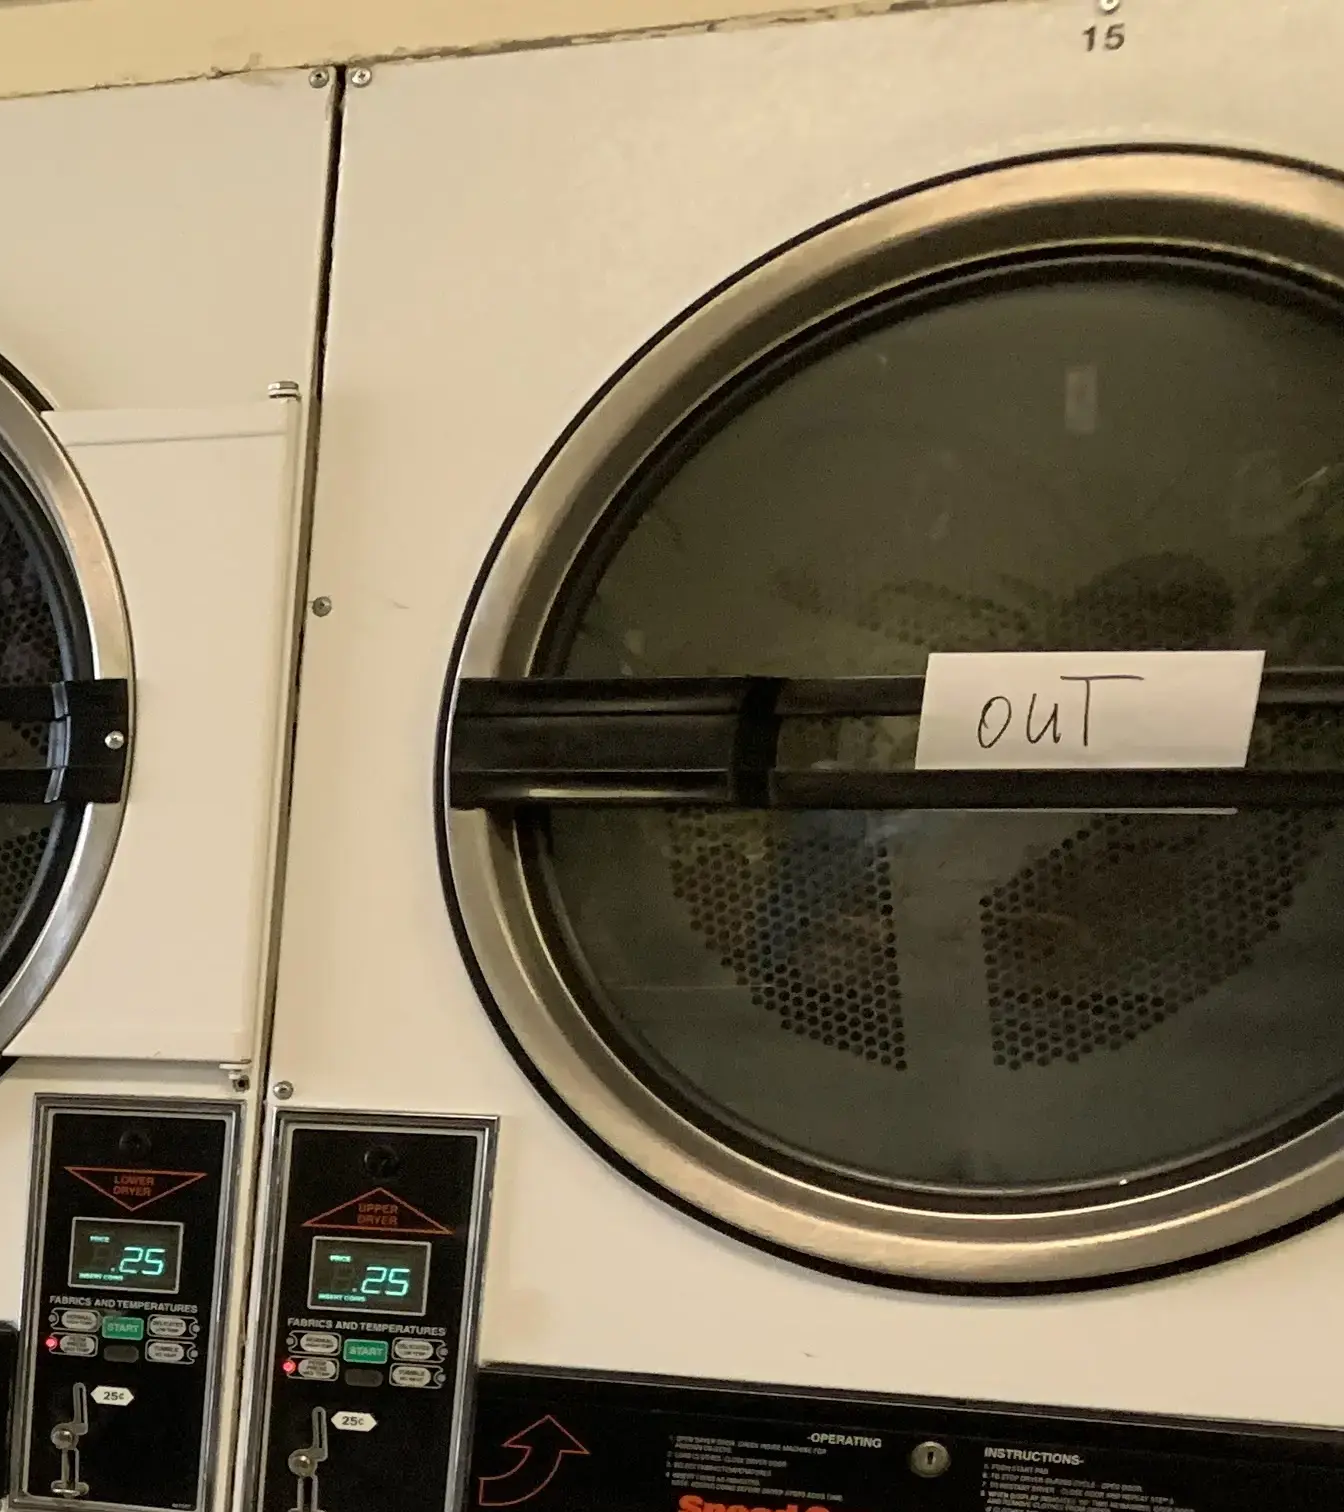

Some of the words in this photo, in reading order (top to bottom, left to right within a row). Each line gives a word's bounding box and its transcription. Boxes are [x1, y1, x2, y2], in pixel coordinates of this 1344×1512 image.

[1082, 22, 1125, 52] 15
[114, 1175, 155, 1186] LOWER
[359, 1203, 399, 1214] UPPER
[49, 1295, 91, 1306] FABRICS
[94, 1299, 116, 1309] AND
[117, 1300, 198, 1314] TEMPERATURES
[106, 1323, 140, 1333] START
[287, 1318, 333, 1330] FABRICS
[335, 1320, 358, 1331] AND
[359, 1322, 447, 1337] TEMPERATURES
[348, 1346, 384, 1357] START
